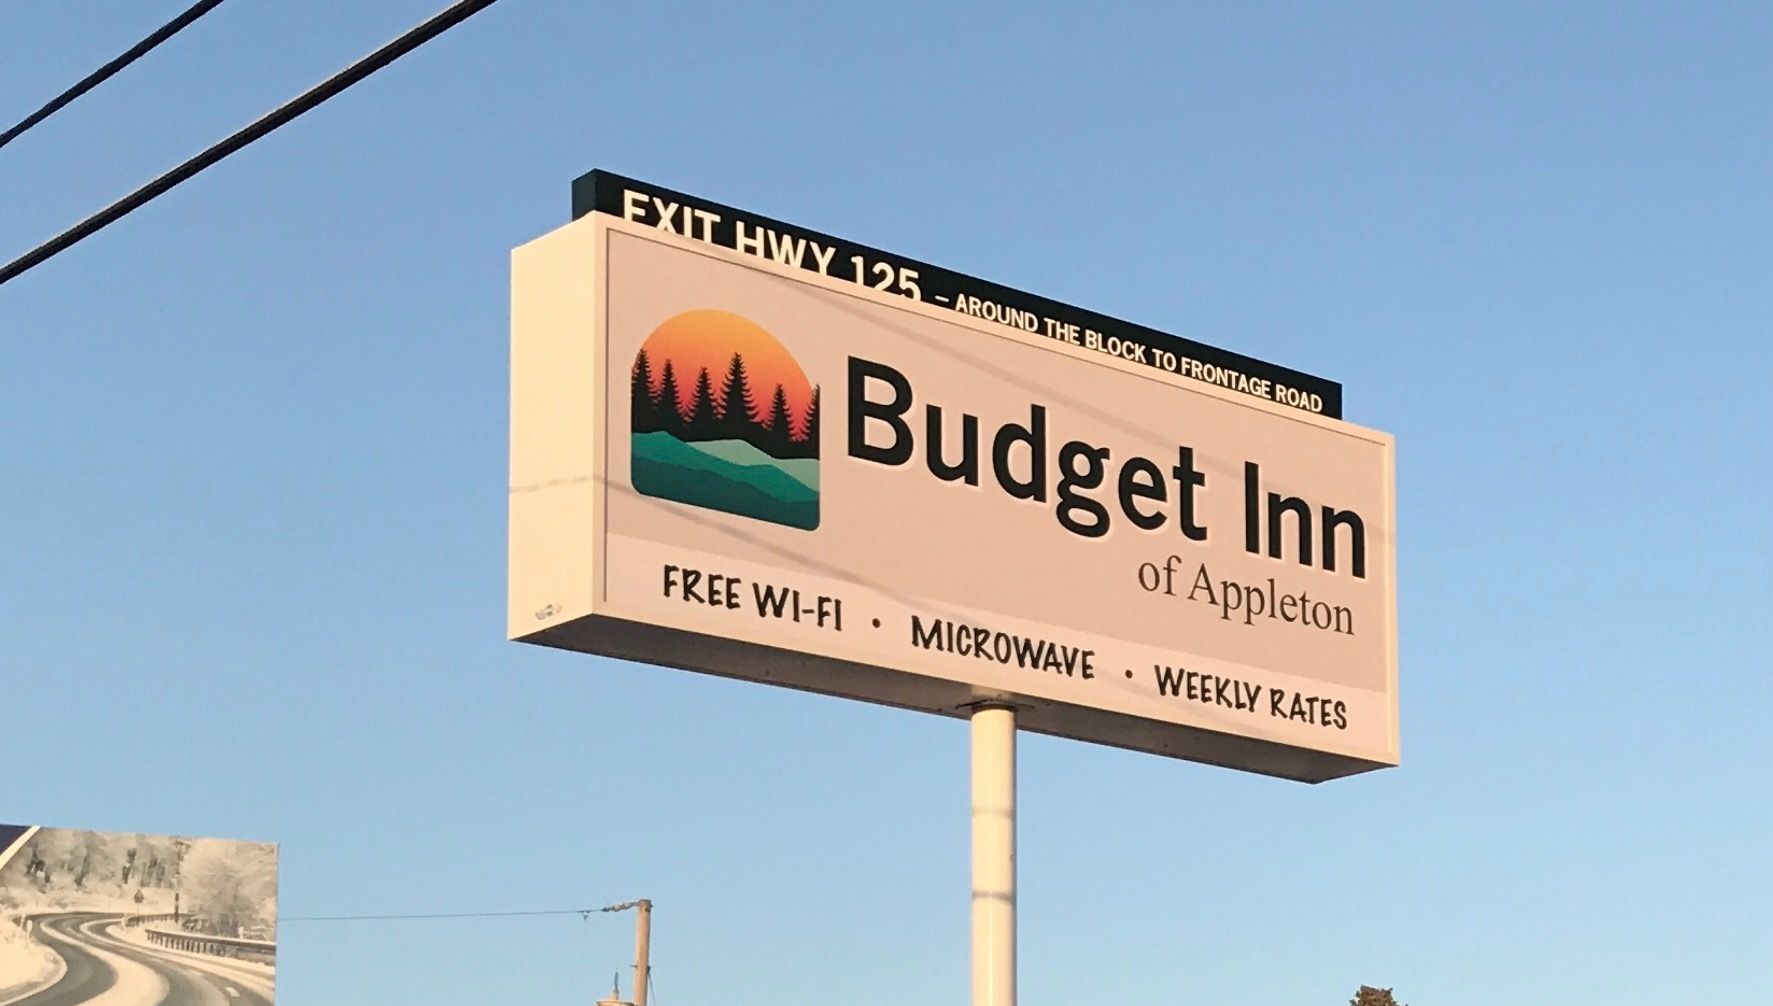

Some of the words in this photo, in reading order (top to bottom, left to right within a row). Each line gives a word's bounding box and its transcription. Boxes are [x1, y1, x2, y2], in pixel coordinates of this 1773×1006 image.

[623, 188, 721, 245] EXIT
[735, 220, 837, 276] HWY
[850, 255, 922, 302] 125
[954, 293, 1039, 334] AROUND
[1043, 317, 1081, 346] THE
[1084, 329, 1147, 364] BLOCK
[1152, 348, 1177, 372] TO
[1180, 356, 1272, 400] FRONTAGE
[1274, 383, 1323, 413] ROAD
[847, 355, 1208, 538] Budget
[1243, 460, 1366, 579] Inn
[663, 564, 743, 610] FREE
[752, 582, 843, 632] WI-FI
[911, 614, 1096, 680] MICROWAVE
[1153, 664, 1263, 713] WEEKLY
[1269, 688, 1348, 731] RATES
[1137, 554, 1183, 597] of
[1186, 562, 1356, 637] Appleton
